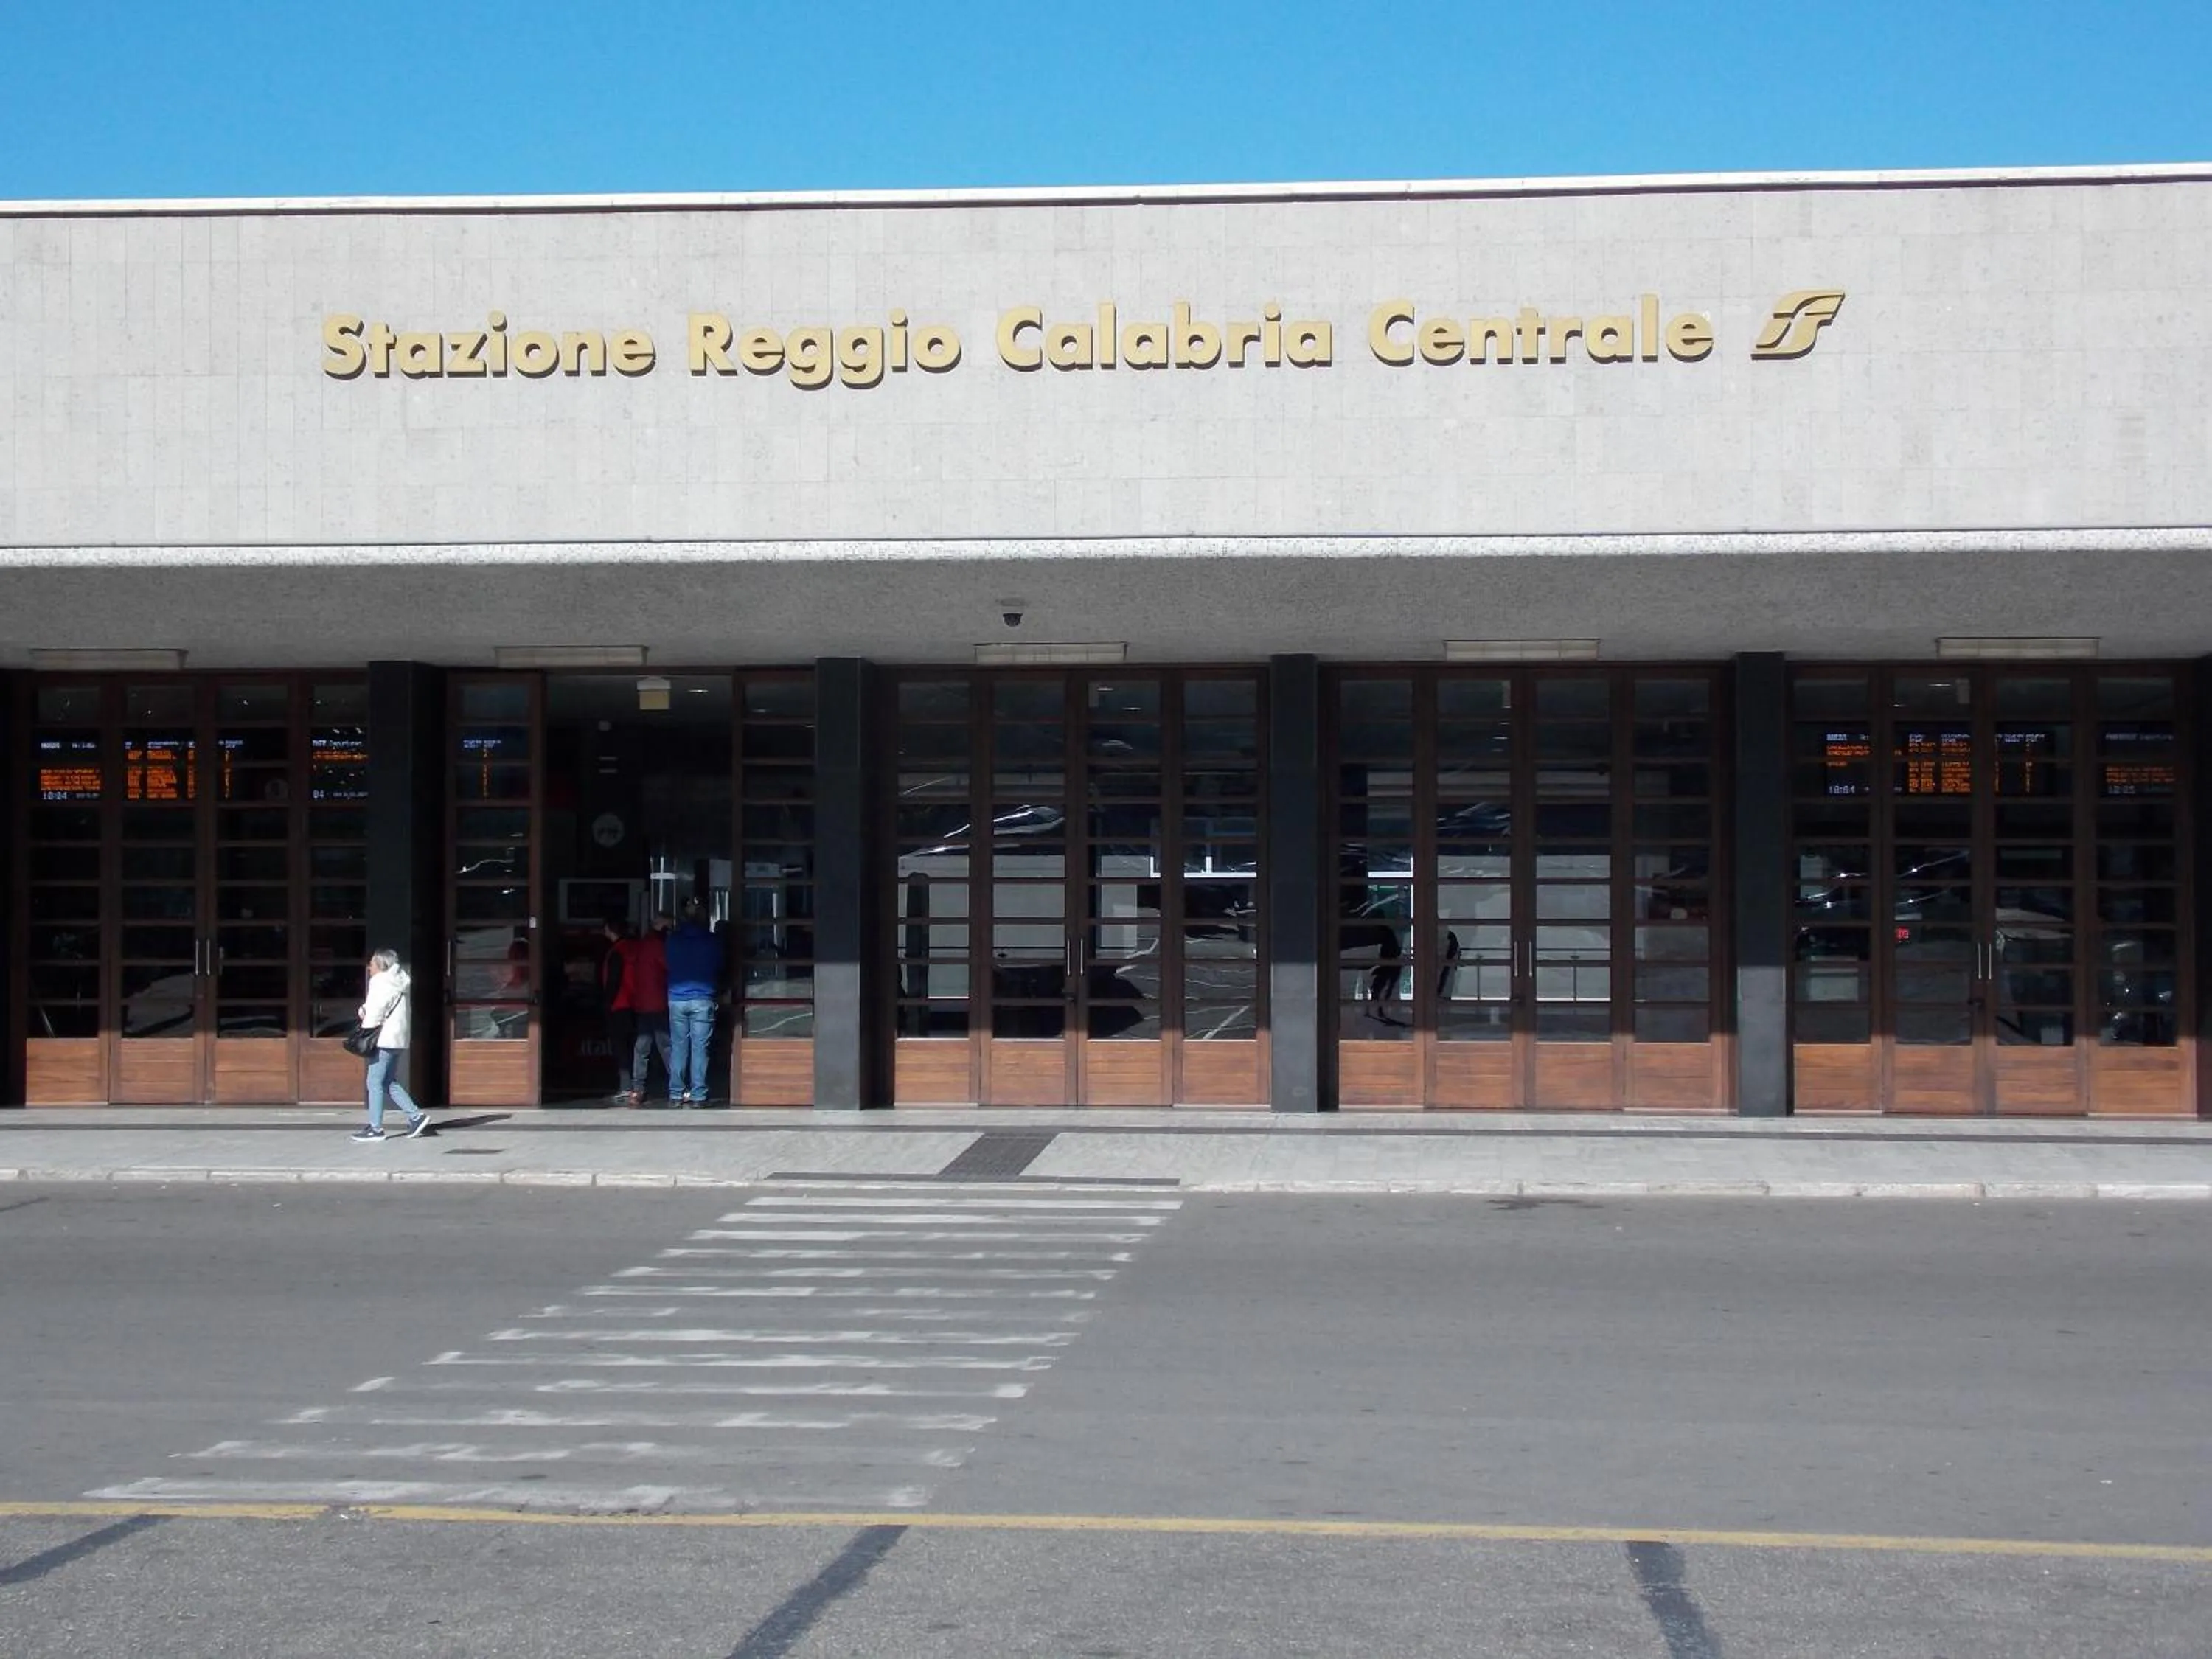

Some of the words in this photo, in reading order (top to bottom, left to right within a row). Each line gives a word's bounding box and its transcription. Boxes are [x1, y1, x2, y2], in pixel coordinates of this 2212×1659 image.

[321, 310, 656, 378] Stazione
[688, 307, 961, 390] Reggio
[996, 300, 1333, 371] Calabria
[1369, 293, 1714, 366] Centrale
